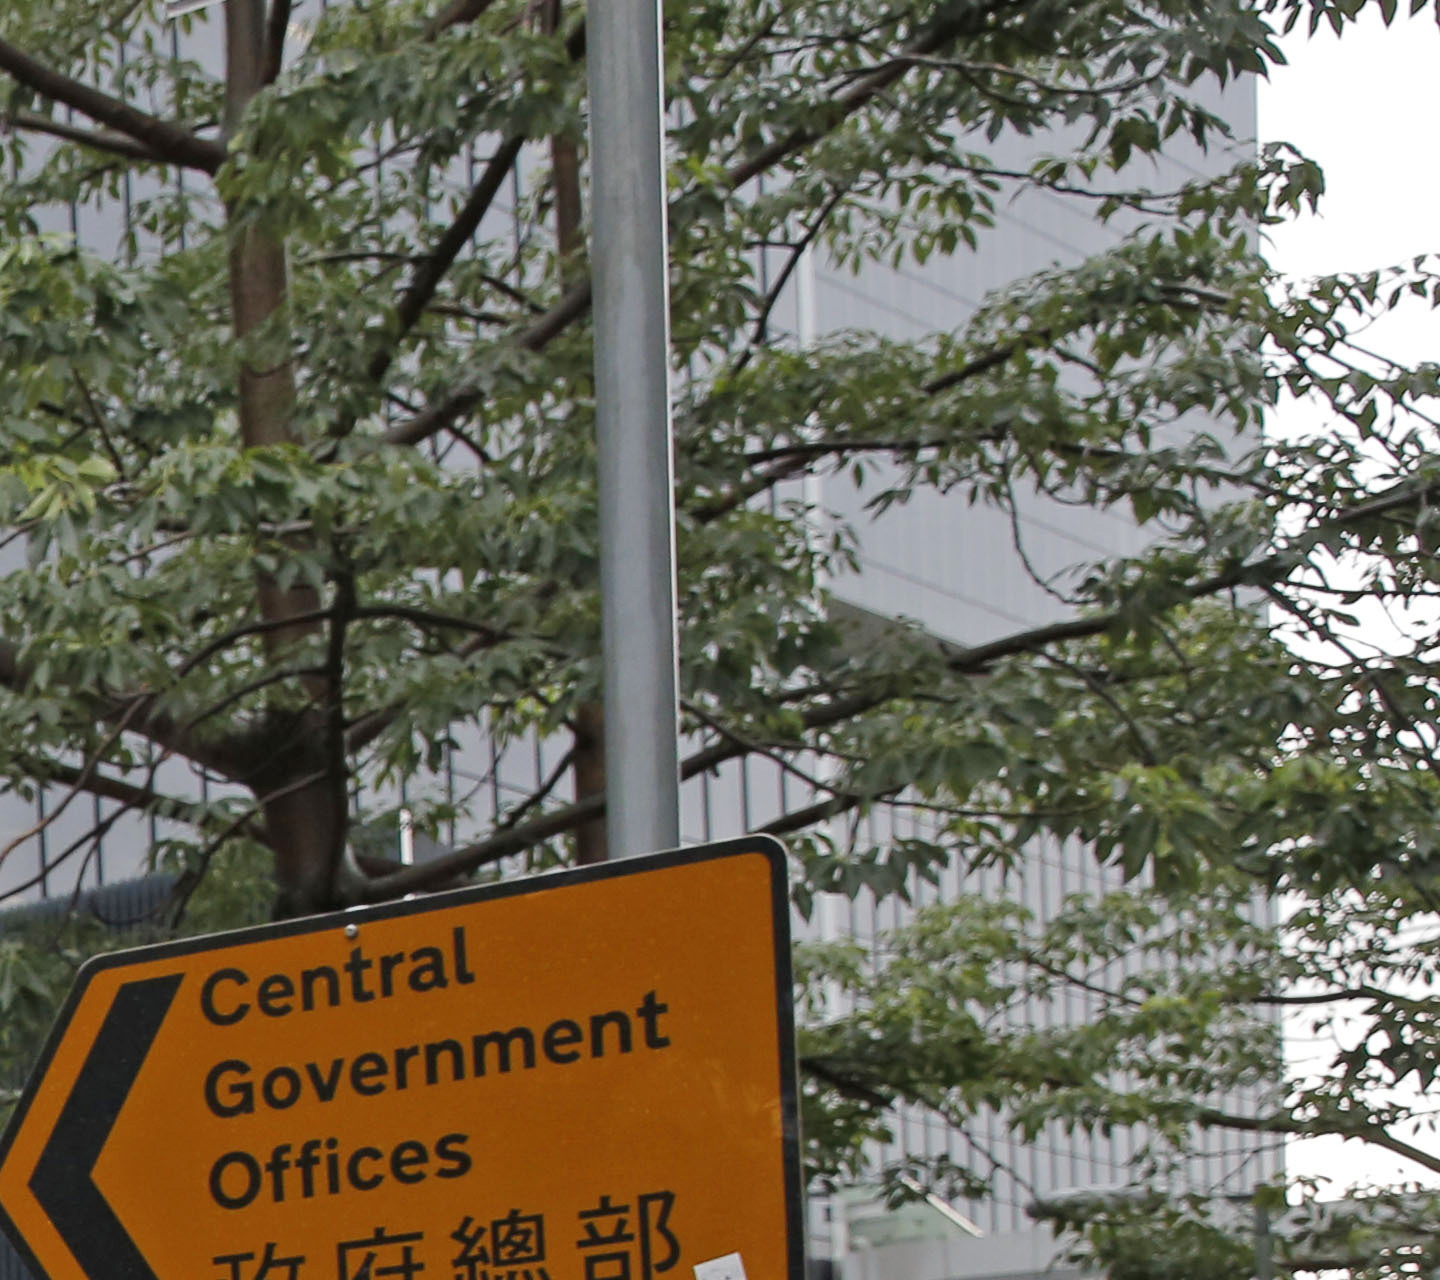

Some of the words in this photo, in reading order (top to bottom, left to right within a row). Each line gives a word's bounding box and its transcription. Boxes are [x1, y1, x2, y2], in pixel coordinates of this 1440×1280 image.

[201, 926, 475, 1026] Central
[204, 990, 671, 1118] Government
[209, 1132, 473, 1210] Offices
